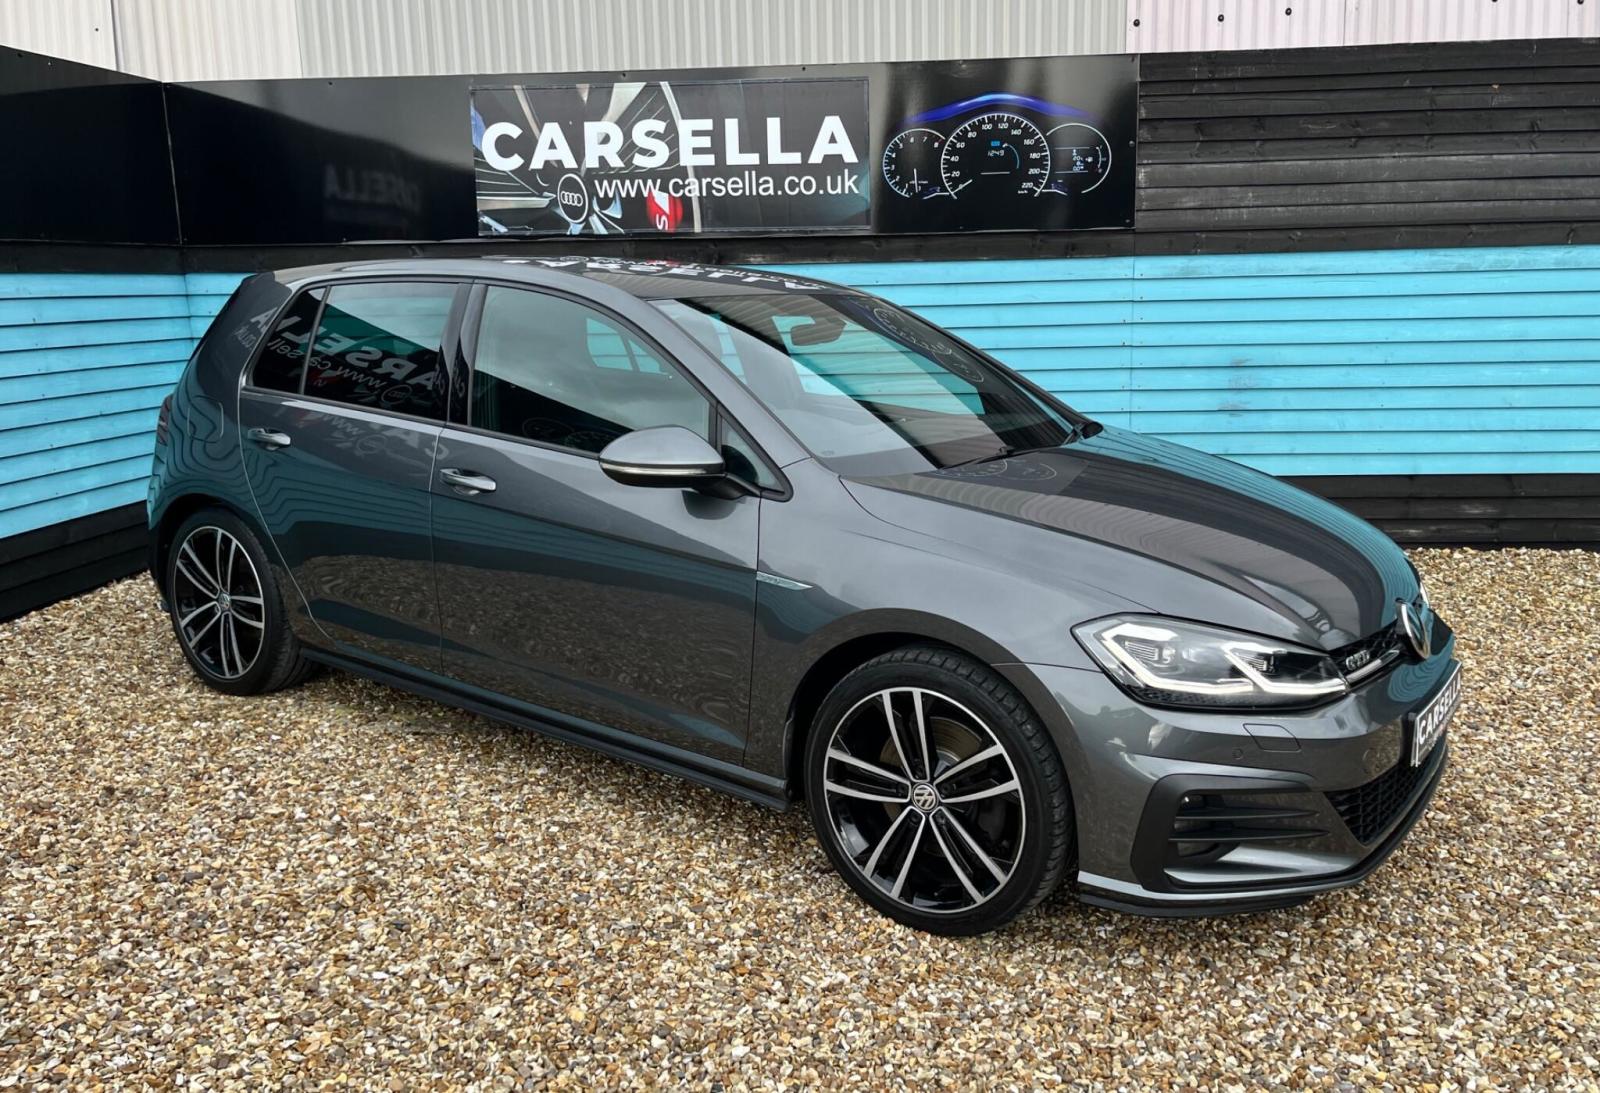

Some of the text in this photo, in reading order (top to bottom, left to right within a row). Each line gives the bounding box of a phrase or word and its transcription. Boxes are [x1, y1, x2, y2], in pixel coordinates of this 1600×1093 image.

[481, 115, 859, 171] CARSELLA
[594, 169, 859, 199] www.carsella.co.uk
[1419, 671, 1461, 745] CARSELLA
